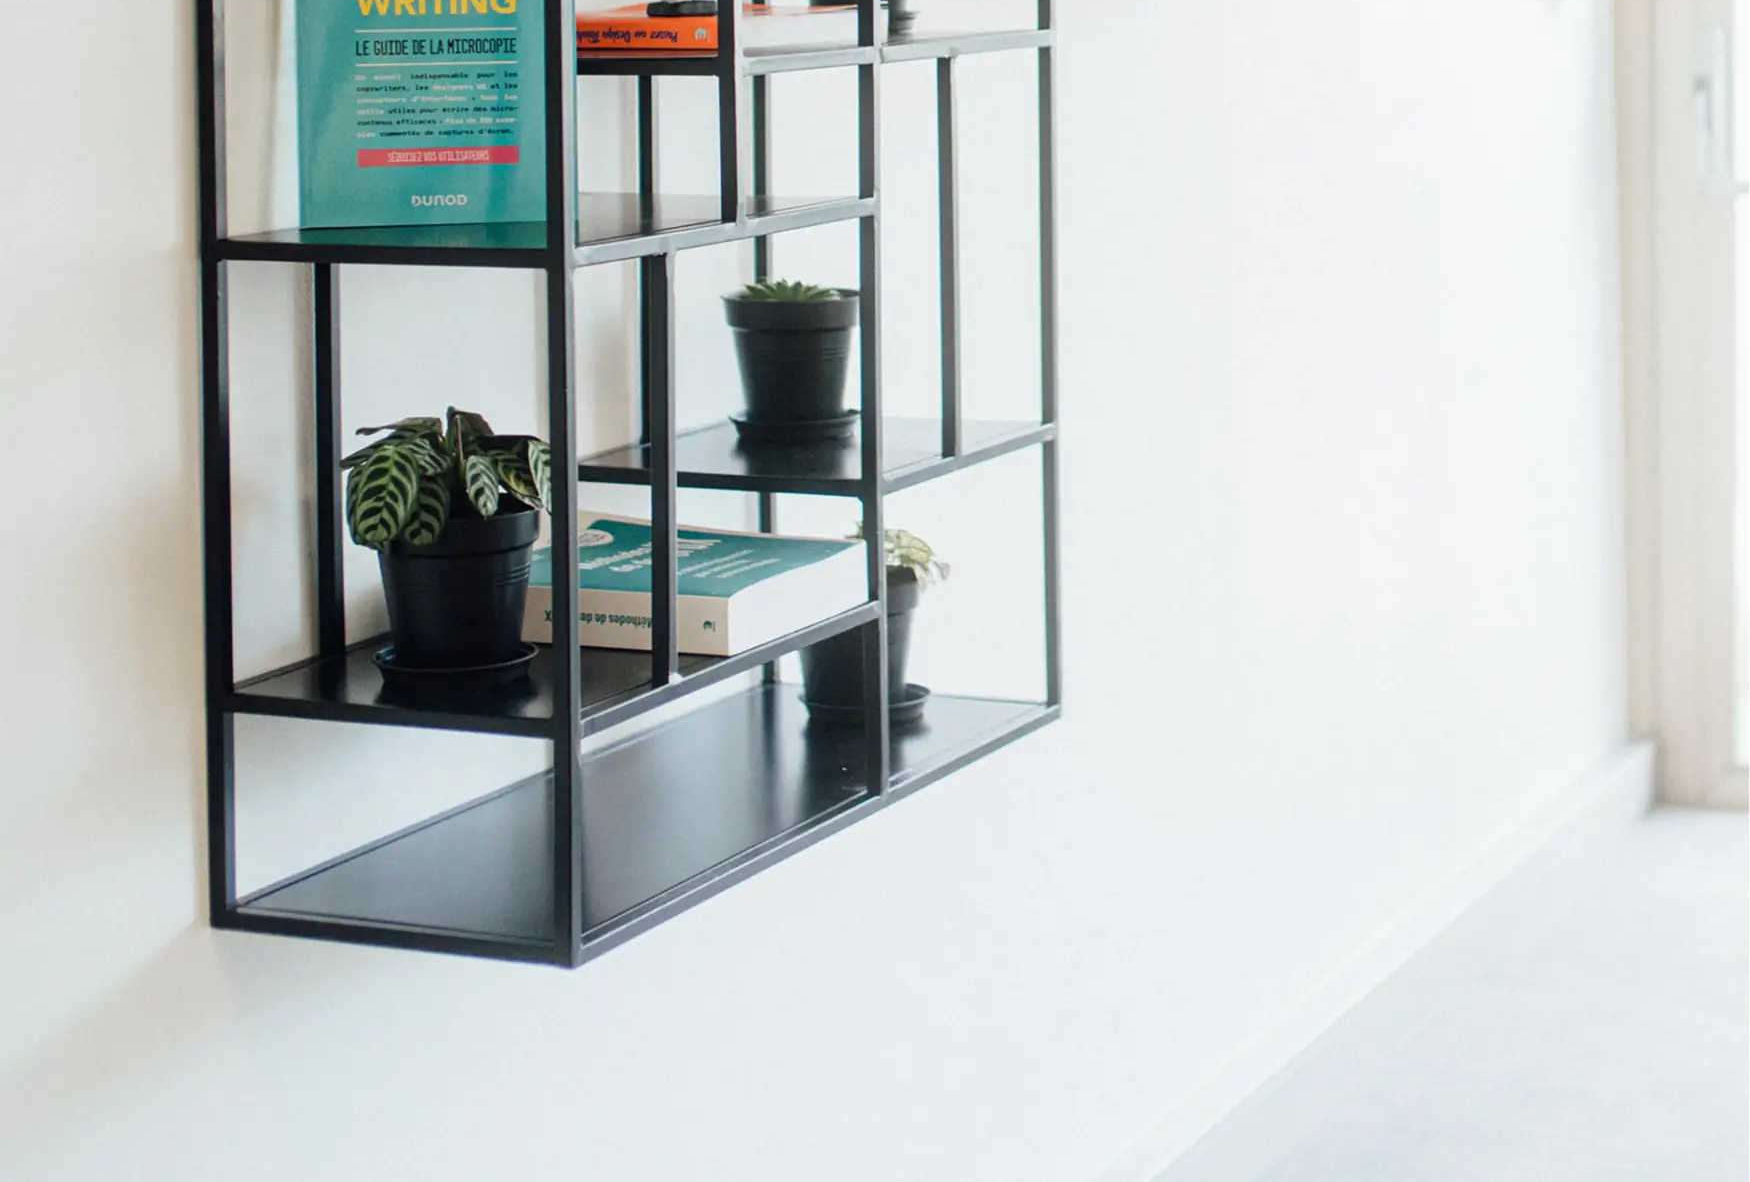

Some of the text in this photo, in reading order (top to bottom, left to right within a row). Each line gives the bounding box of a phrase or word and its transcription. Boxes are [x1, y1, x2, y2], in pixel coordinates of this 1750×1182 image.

[355, 37, 517, 57] LE GUIDE DE LA MICROCOPIE
[411, 72, 469, 80] indispensable
[504, 70, 518, 78] les
[490, 82, 500, 90] et
[504, 81, 518, 89] les
[387, 107, 416, 115] utiles
[419, 107, 438, 115] pour
[473, 105, 487, 113] des
[396, 118, 437, 126] efficaces
[438, 128, 474, 137] captures
[387, 149, 490, 163] SÉDUISEZ VOS UTILISATEURS
[411, 193, 468, 207] DUNOD
[594, 613, 607, 625] de
